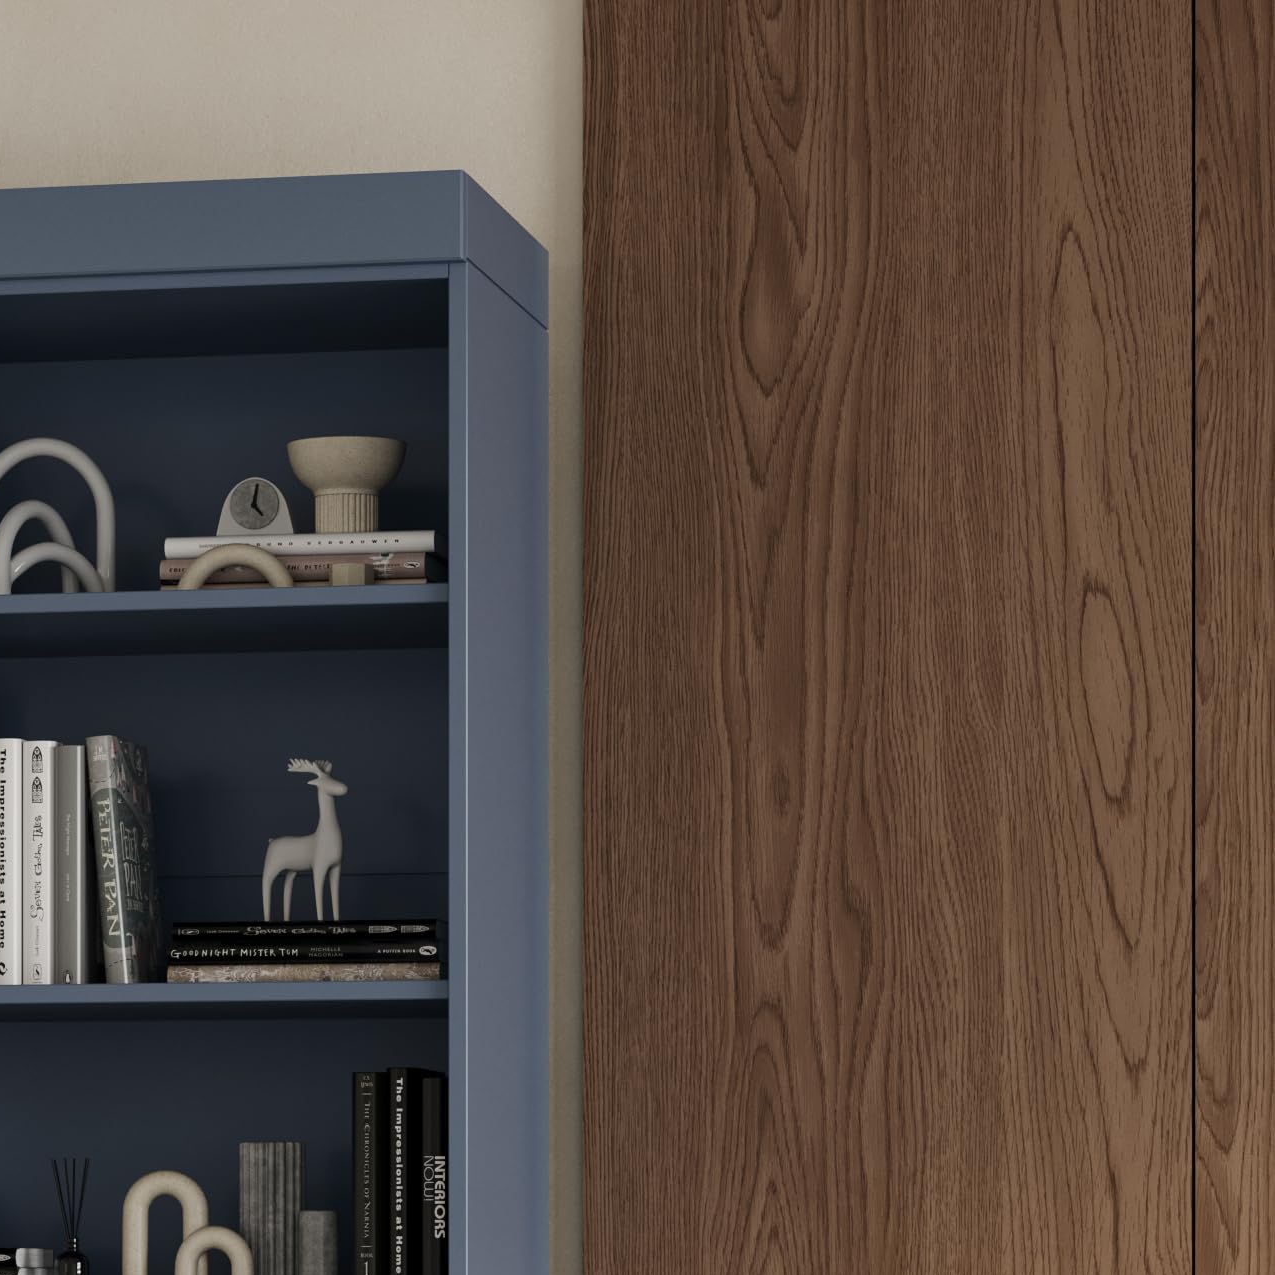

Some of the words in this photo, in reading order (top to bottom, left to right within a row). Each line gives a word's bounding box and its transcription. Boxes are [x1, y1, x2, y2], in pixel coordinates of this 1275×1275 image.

[0, 748, 7, 774] The
[97, 798, 114, 871] PETER
[0, 890, 7, 906] at
[103, 879, 121, 938] PAN
[0, 910, 7, 949] Home
[240, 948, 277, 958] MISTER
[278, 947, 300, 958] TOM
[395, 1077, 404, 1102] The
[363, 1101, 371, 1120] THE
[363, 1122, 372, 1185] CHRONICLES
[394, 1107, 404, 1212] Impressionists
[363, 1187, 371, 1200] OF
[423, 1155, 435, 1202] NOW!
[434, 1155, 446, 1239] INTERIORS
[363, 1202, 372, 1239] NARNIA
[395, 1216, 403, 1230] at
[395, 1235, 404, 1274] Home
